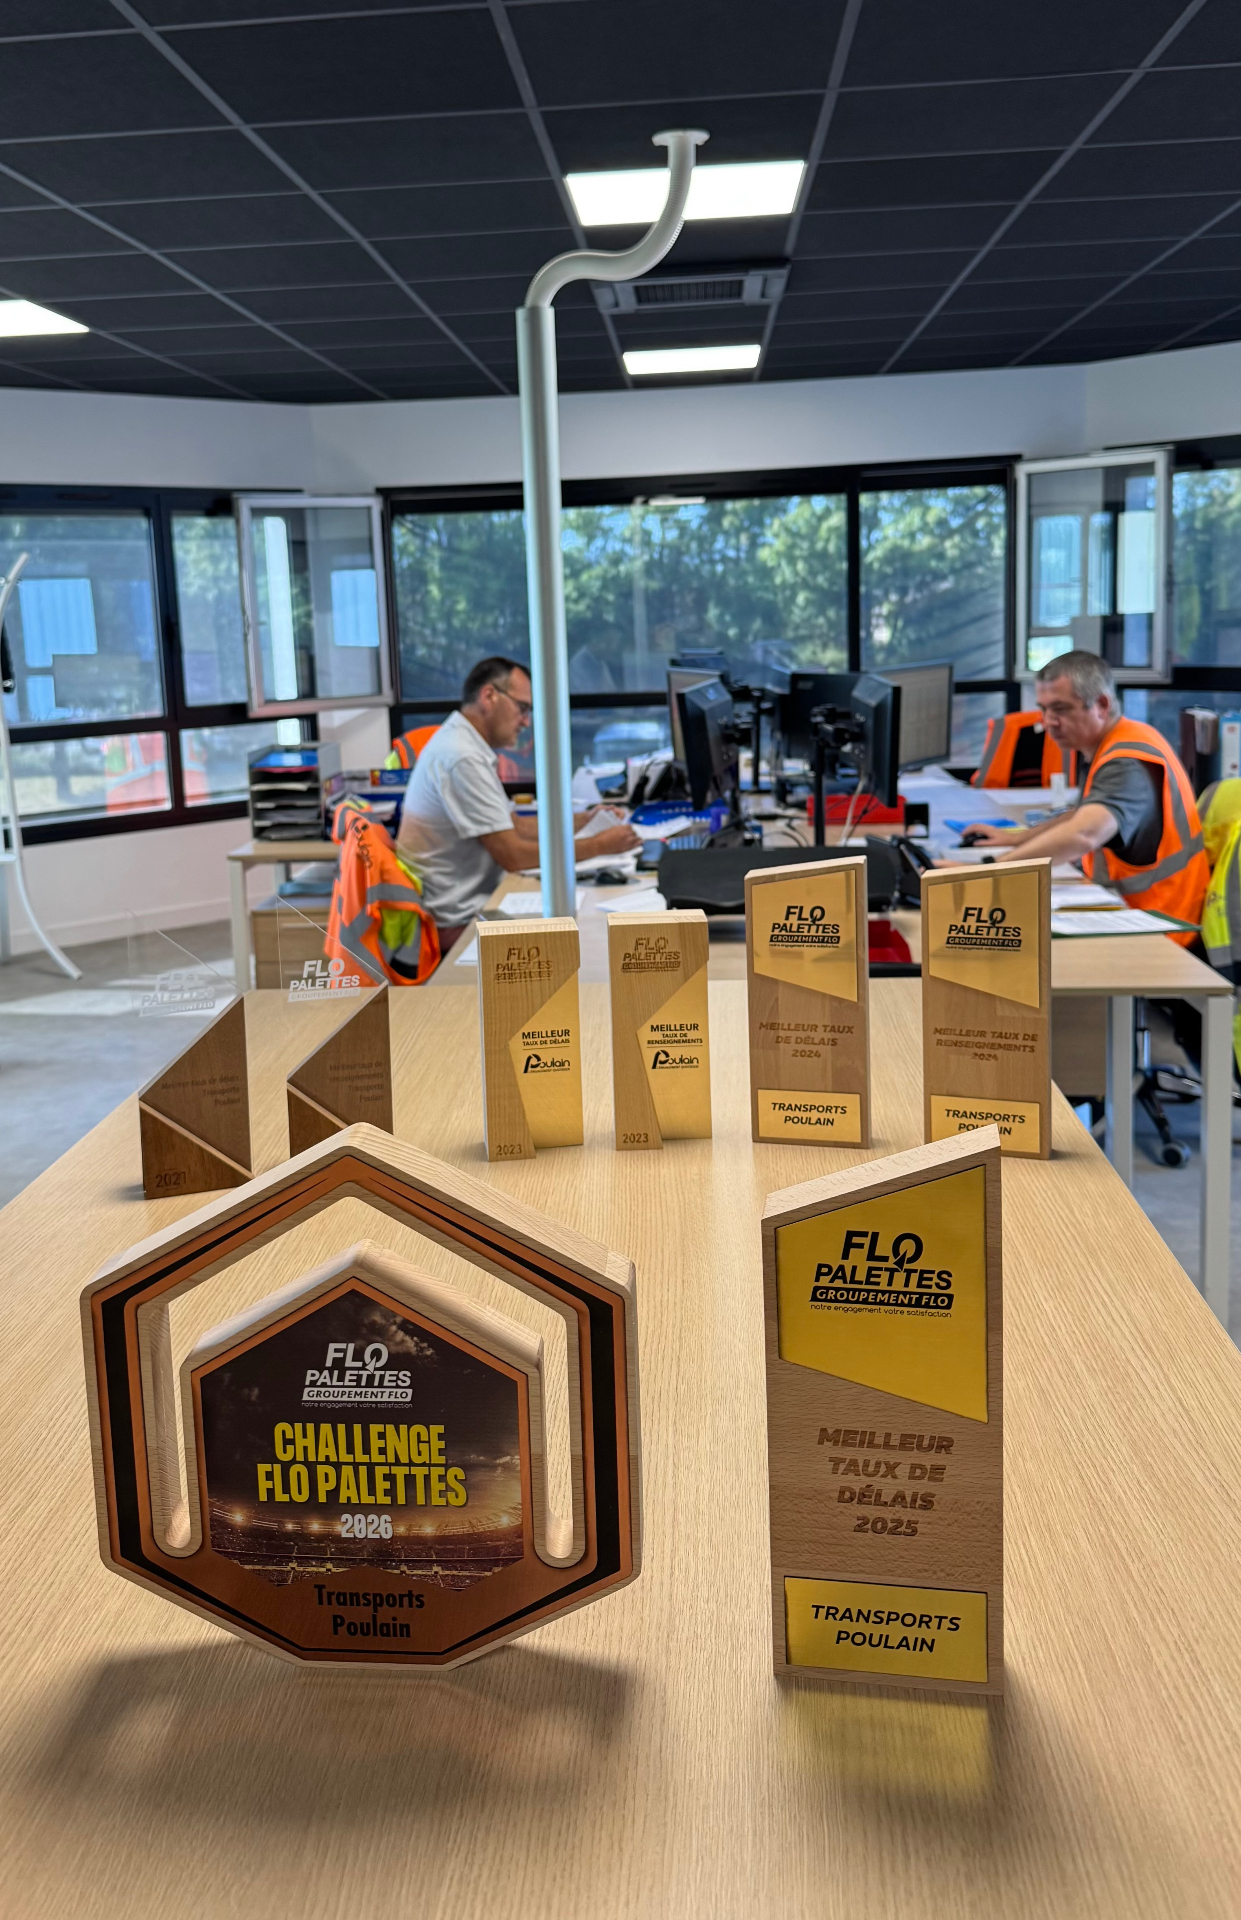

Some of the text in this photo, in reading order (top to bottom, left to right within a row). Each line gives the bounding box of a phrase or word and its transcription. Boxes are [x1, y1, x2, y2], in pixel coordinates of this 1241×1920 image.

[784, 905, 826, 923] FLO
[962, 906, 1006, 927] FLO
[771, 922, 840, 934] PALETTES
[948, 924, 1021, 938] PALETTES
[635, 936, 669, 952] FLO
[772, 935, 838, 944] GROUPEMENT FLO
[948, 937, 1020, 947] GROUPEMENT FLO
[507, 945, 541, 961] FLO
[622, 950, 681, 962] PALETTES
[302, 958, 345, 979] FLO
[289, 975, 360, 992] PALETTES
[521, 1029, 571, 1040] MEILLEUR
[651, 1023, 699, 1033] MEILLEUR
[759, 1022, 854, 1034] MEILLEUR TAUX
[933, 1027, 1038, 1042] MEILLEUR TAUX DE
[549, 1037, 570, 1045] DÉLAIS
[775, 1033, 838, 1047] DE DÉLAIS
[936, 1038, 1036, 1053] RENSEIGNEMENTS
[651, 1050, 699, 1069] Poulain
[791, 1049, 821, 1058] 2024
[971, 1052, 999, 1061] 2024
[523, 1053, 571, 1073] Poulain
[771, 1102, 848, 1115] TRANSPORTS
[945, 1109, 1026, 1124] TRANSPORTS
[784, 1115, 835, 1127] POULAIN
[958, 1123, 1012, 1136] POIN
[622, 1133, 649, 1144] 2023
[496, 1144, 522, 1156] 2023
[155, 1171, 187, 1188] 2021
[841, 1230, 924, 1265] FLO
[814, 1263, 953, 1290] PALETTES
[816, 1289, 949, 1307] GROUPEMENT FLO
[810, 1303, 832, 1311] notre
[834, 1305, 882, 1314] engagement
[906, 1309, 952, 1318] satisfaction
[325, 1342, 389, 1370] FLO
[305, 1370, 411, 1387] PALETTES
[307, 1389, 409, 1399] GROUPEMENT FLO
[274, 1422, 446, 1464] CHALLENGE
[817, 1427, 955, 1455] MEILLEUR
[828, 1456, 946, 1482] TAUX DE
[257, 1463, 468, 1507] FLO PALETTES
[837, 1484, 936, 1510] DÉLAIS
[340, 1513, 393, 1539] 2026
[853, 1516, 919, 1537] 2025
[314, 1584, 426, 1613] Transports
[332, 1613, 411, 1638] Poulain
[811, 1604, 962, 1632] TRANSPORTS
[835, 1630, 936, 1653] POULAIN
